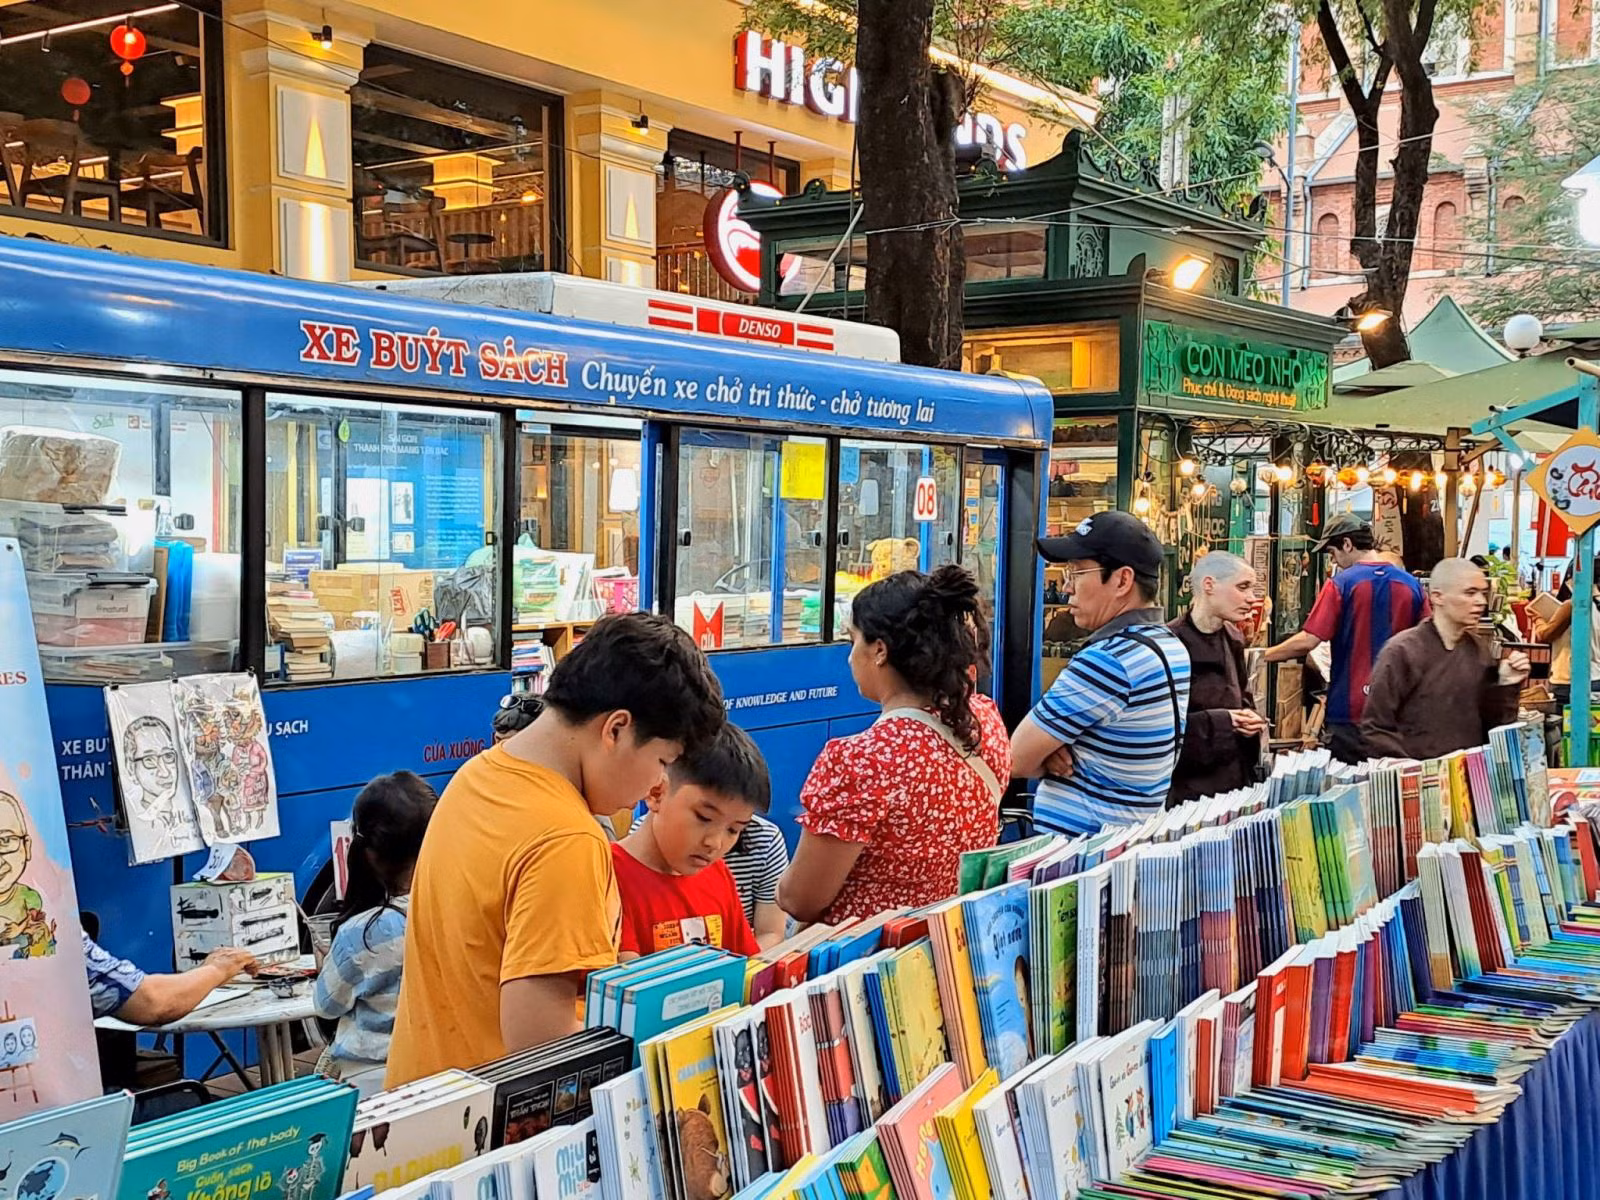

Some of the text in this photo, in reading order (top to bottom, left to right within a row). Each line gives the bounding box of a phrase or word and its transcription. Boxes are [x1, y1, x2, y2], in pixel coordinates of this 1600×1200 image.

[738, 320, 782, 338] DENSO
[300, 320, 569, 388] XE BUÝT SÁCH
[1187, 341, 1225, 377] CON
[581, 360, 667, 399] Chuyến
[675, 381, 698, 399] xe
[706, 375, 743, 404] chở
[749, 382, 771, 407] tri
[777, 383, 816, 411] thức
[830, 389, 862, 416] chở
[867, 396, 911, 425] tương
[916, 399, 936, 423] lai
[917, 483, 935, 515] 08
[736, 691, 787, 709] KNOWLEDGE
[789, 689, 807, 702] AND
[808, 685, 839, 699] FUTURE
[275, 719, 309, 739] SẠCH
[62, 737, 109, 756] XE BU
[176, 1125, 301, 1173] Big Book of the body
